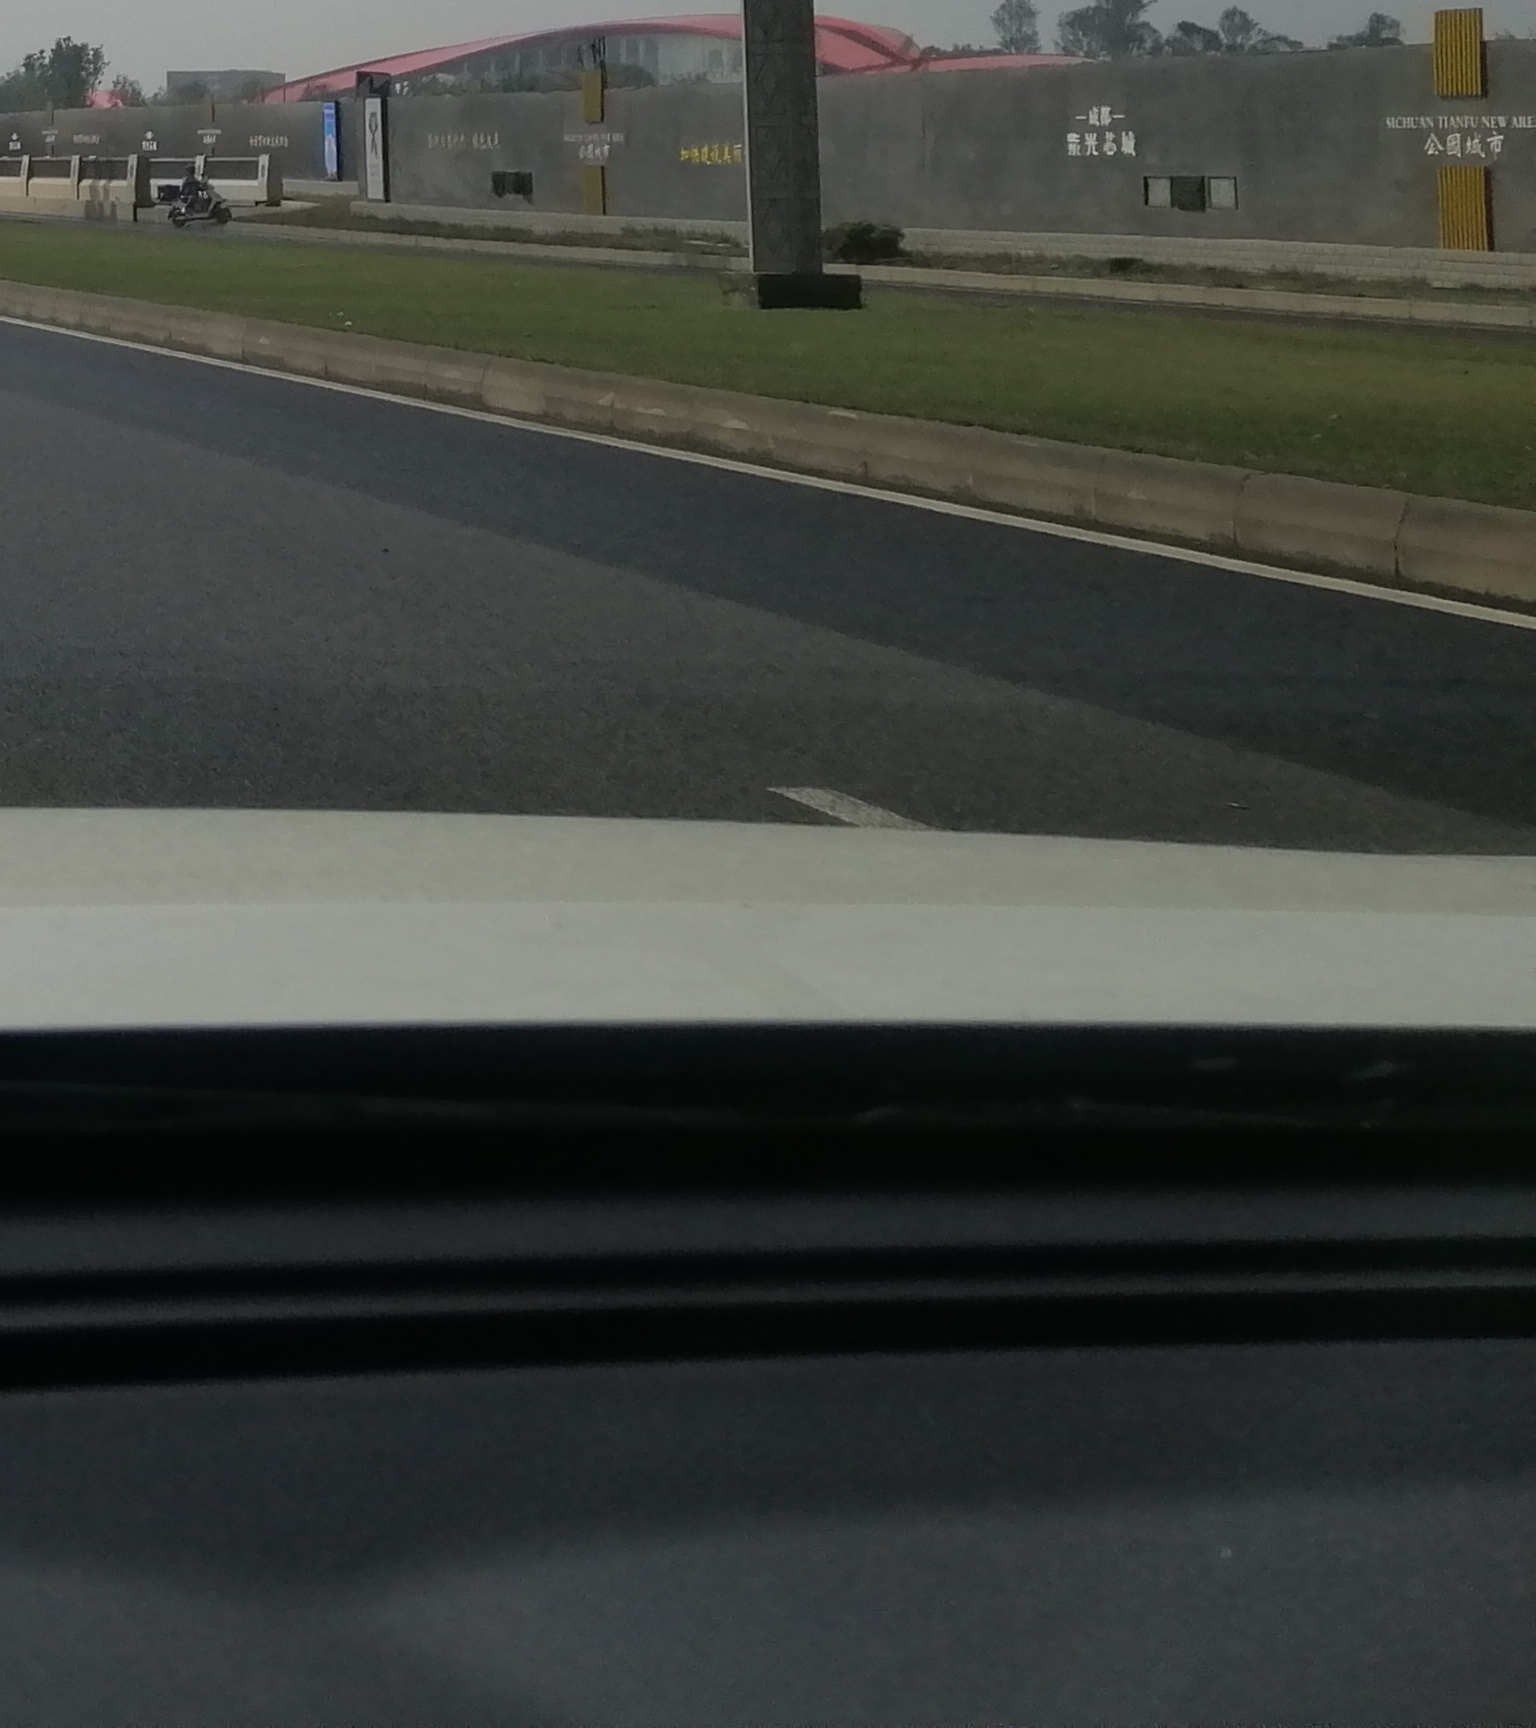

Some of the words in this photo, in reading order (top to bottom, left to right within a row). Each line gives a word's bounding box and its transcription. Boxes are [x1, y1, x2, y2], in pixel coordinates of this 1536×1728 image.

[1386, 116, 1434, 129] SICHUAN
[1437, 115, 1478, 129] TIANFU
[1424, 130, 1505, 160] 公园城市
